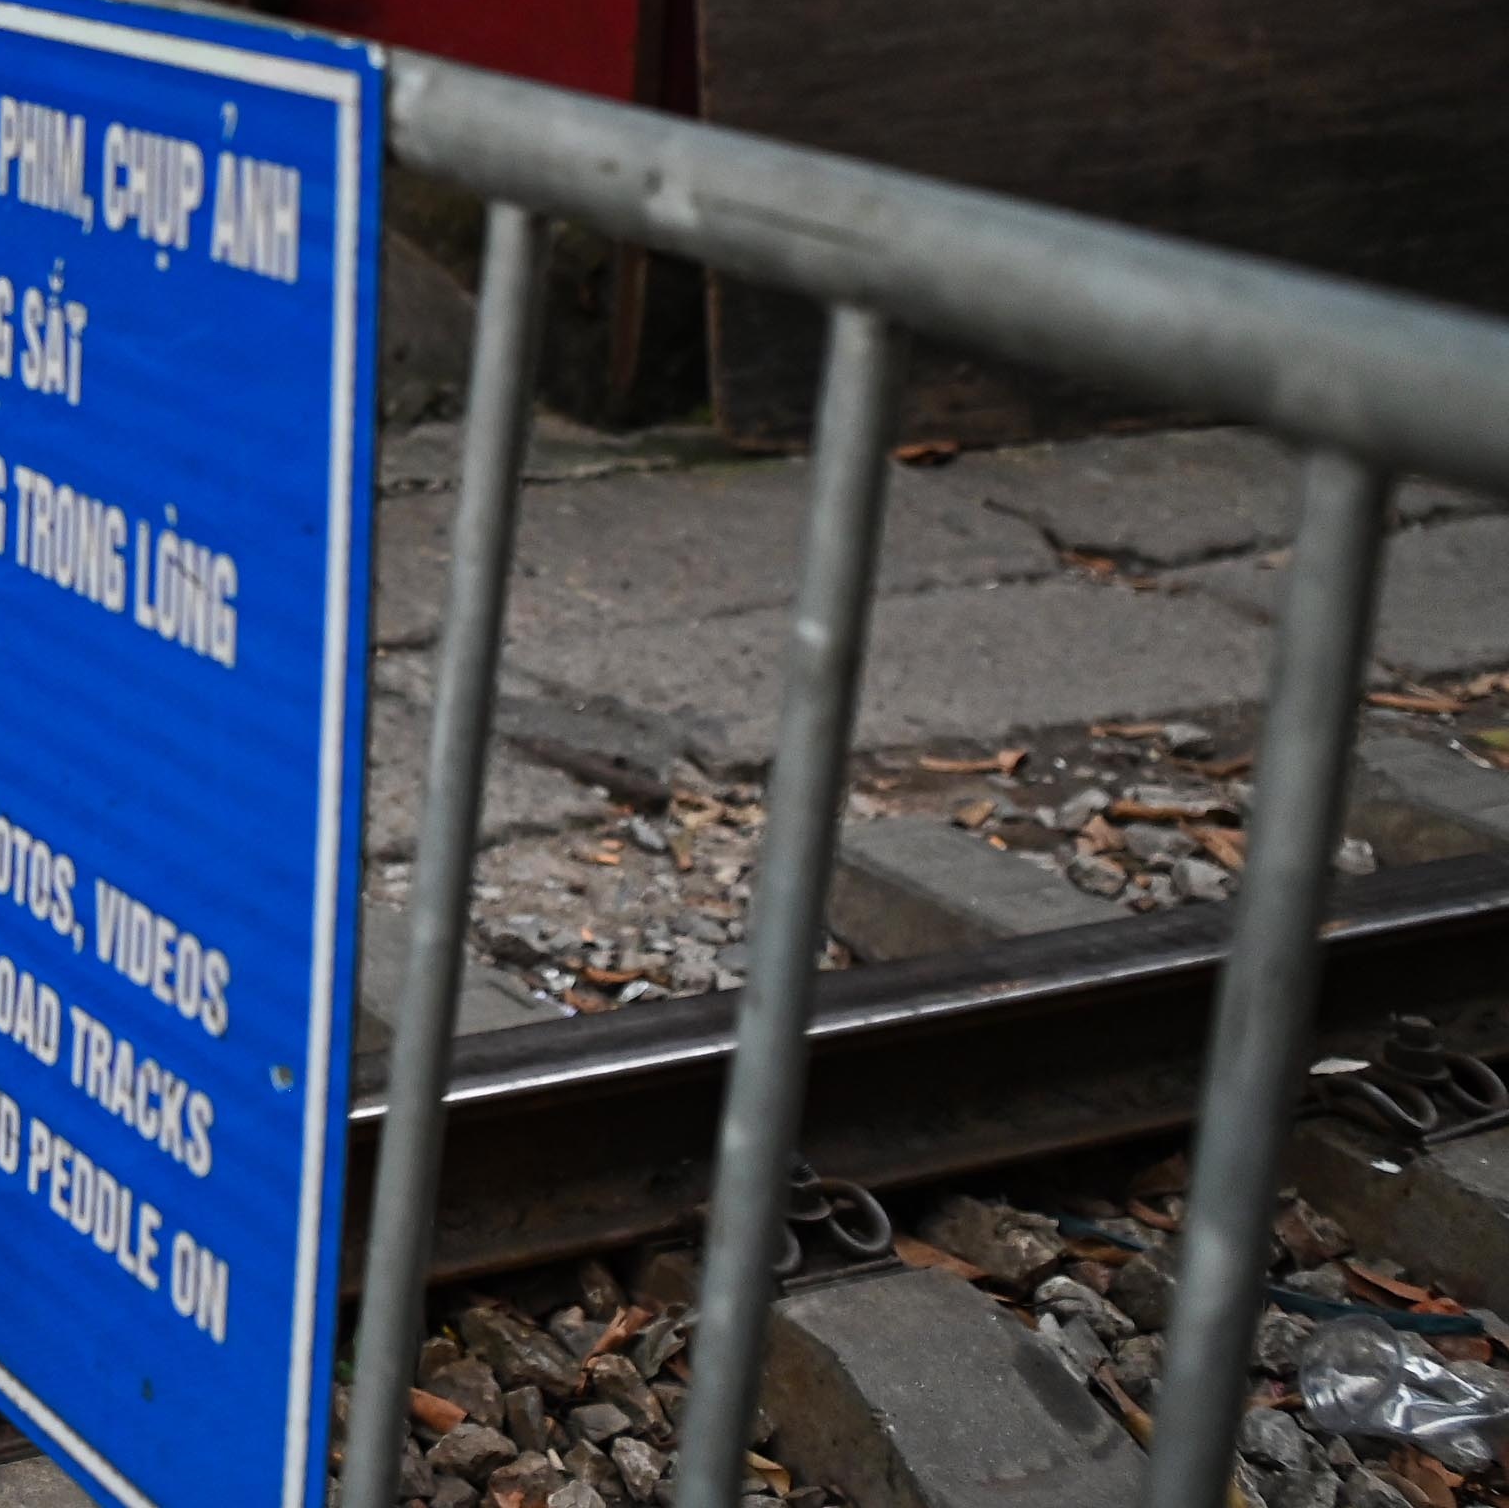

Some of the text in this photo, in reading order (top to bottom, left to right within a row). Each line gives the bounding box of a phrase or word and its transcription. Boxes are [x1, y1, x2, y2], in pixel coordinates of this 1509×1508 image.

[102, 121, 205, 272] CHỤP
[210, 100, 302, 285] ẢNH
[19, 256, 89, 407] SẮT
[13, 463, 128, 615] TRONG
[133, 502, 239, 670] LÒNG
[93, 876, 232, 1039] VIDEOS
[70, 1004, 215, 1180] TRACKS
[27, 1115, 163, 1293] PEDDLE
[169, 1228, 231, 1346] ON
